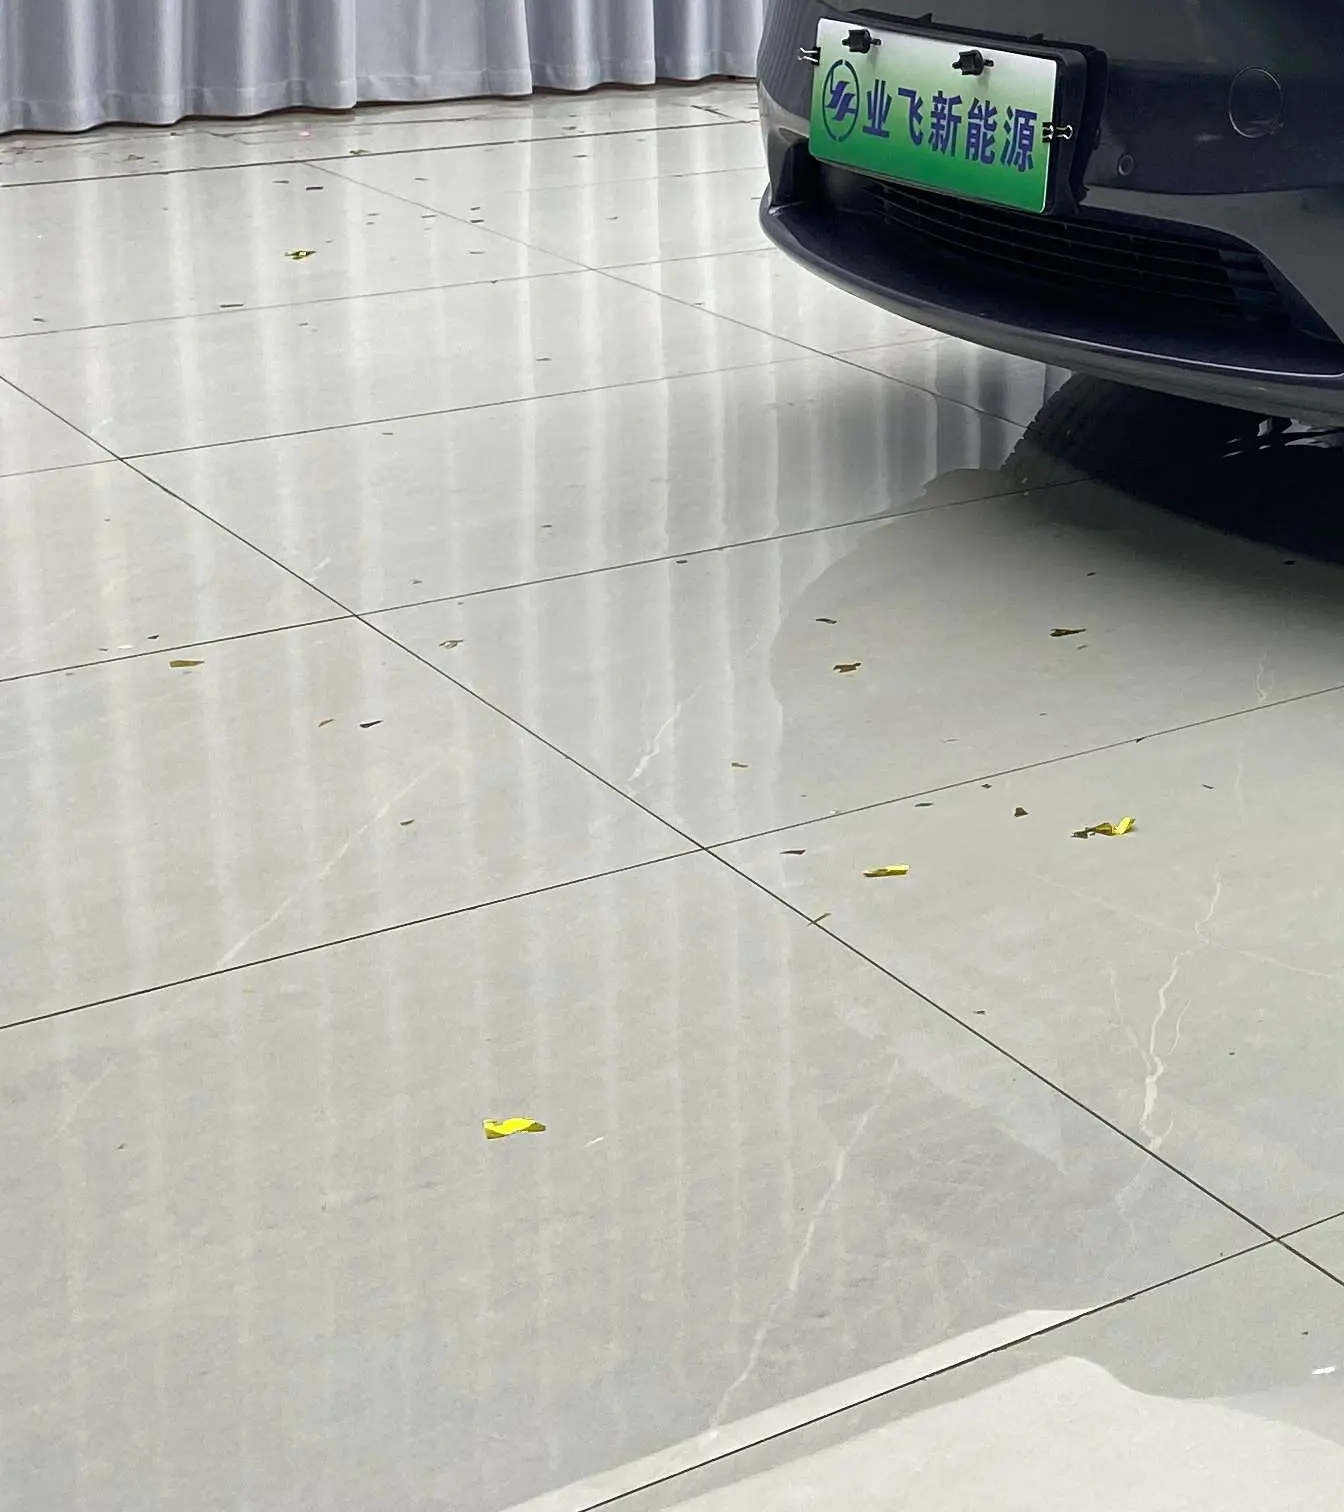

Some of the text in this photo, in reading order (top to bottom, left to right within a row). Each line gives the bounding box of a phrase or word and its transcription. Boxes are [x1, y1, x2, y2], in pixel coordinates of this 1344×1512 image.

[862, 79, 1037, 172] 业飞新能源
